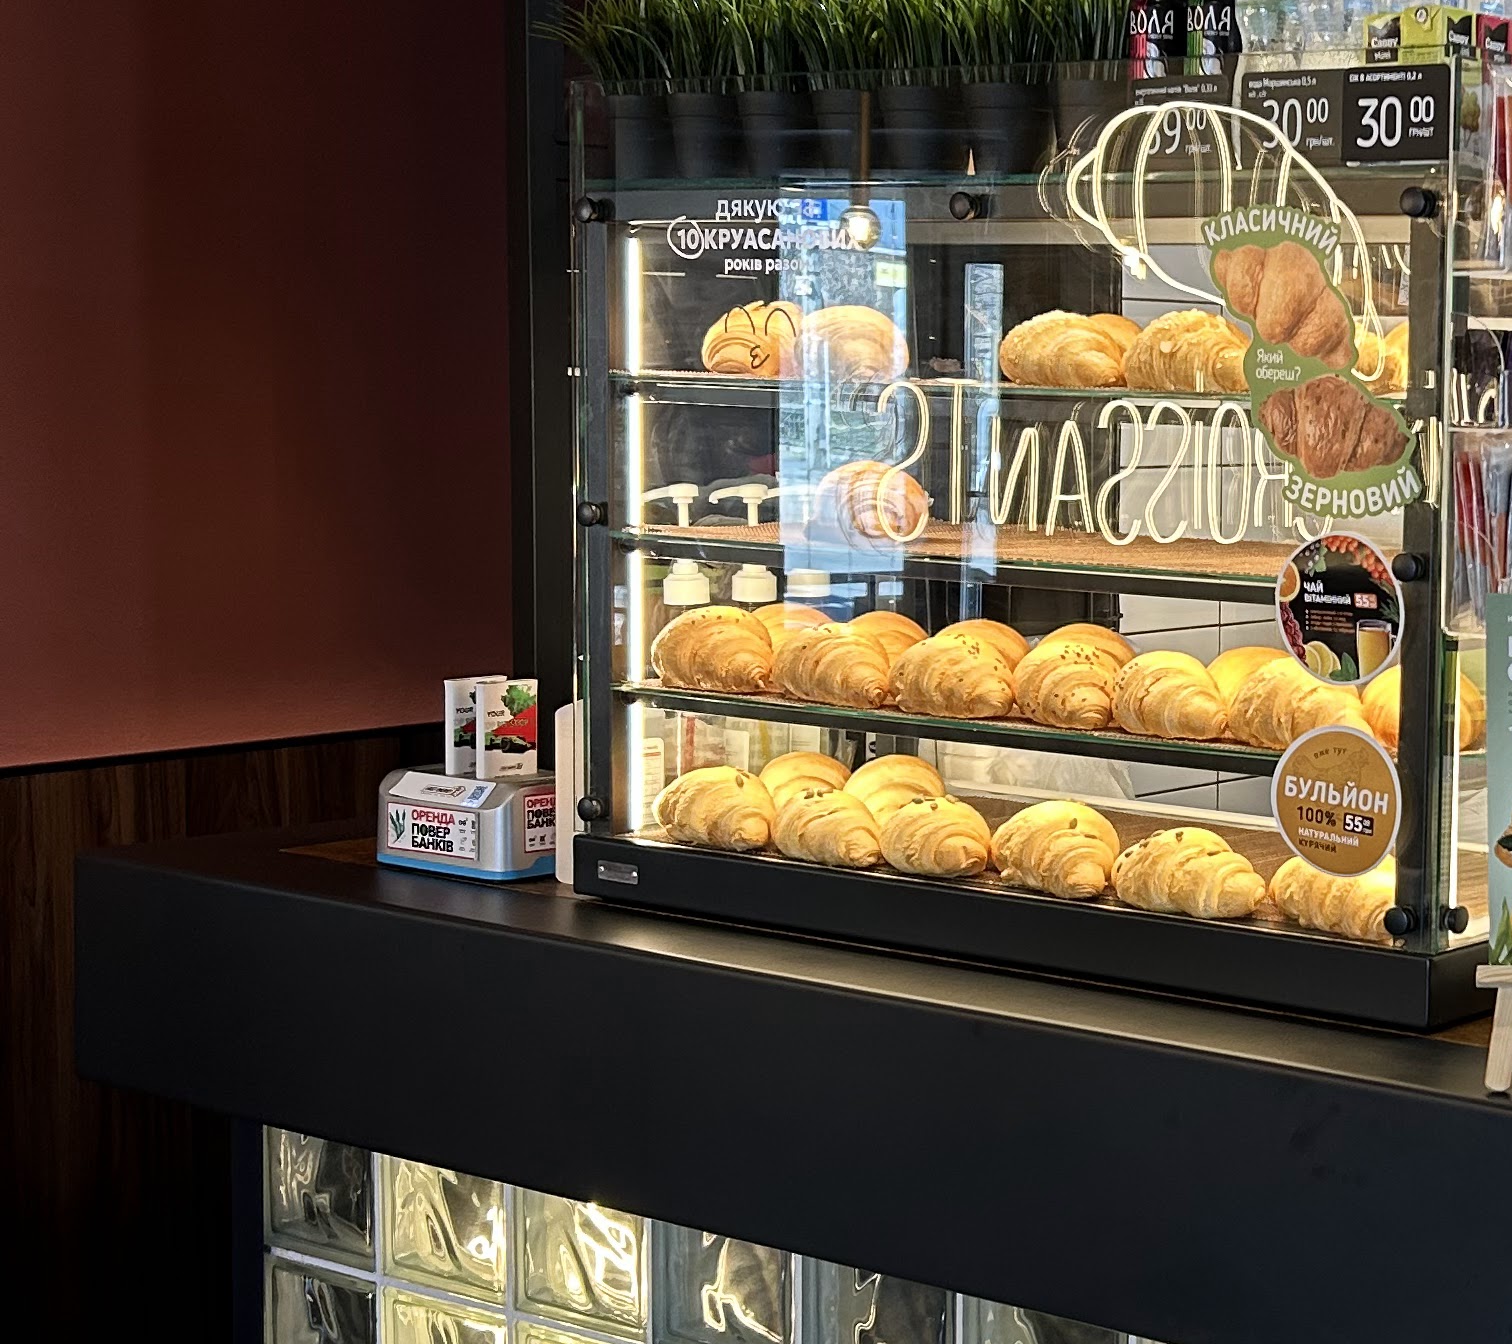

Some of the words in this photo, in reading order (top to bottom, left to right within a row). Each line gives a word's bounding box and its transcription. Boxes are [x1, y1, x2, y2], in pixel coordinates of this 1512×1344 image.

[1131, 9, 1174, 35] ВОЛЯ
[1187, 5, 1231, 32] ВОЛЯ
[1263, 98, 1303, 150] 30
[1306, 98, 1329, 124] 00
[1356, 96, 1402, 148] 30
[1409, 95, 1435, 123] 00
[678, 229, 700, 250] 10
[1204, 209, 1338, 255] КЛАСИЧНИЙ
[725, 258, 762, 274] років
[765, 259, 806, 274] разо
[1257, 349, 1283, 364] Який
[1256, 366, 1301, 383] обереш?
[1285, 467, 1420, 513] ЗЕРНОВИЙ
[1304, 580, 1323, 593] ЧАЙ
[1356, 595, 1369, 607] 55
[1285, 775, 1388, 815] БУЛЬЙОН
[411, 809, 455, 825] ОРЕНДА
[1297, 806, 1336, 827] 100%
[1345, 815, 1363, 832] 55
[412, 823, 450, 839] ПОВЕР
[1298, 827, 1358, 847] НАТУРАЛЬНИЙ
[411, 835, 454, 853] БАНКІВ
[1299, 838, 1336, 853] КУРЯЧИЙ
